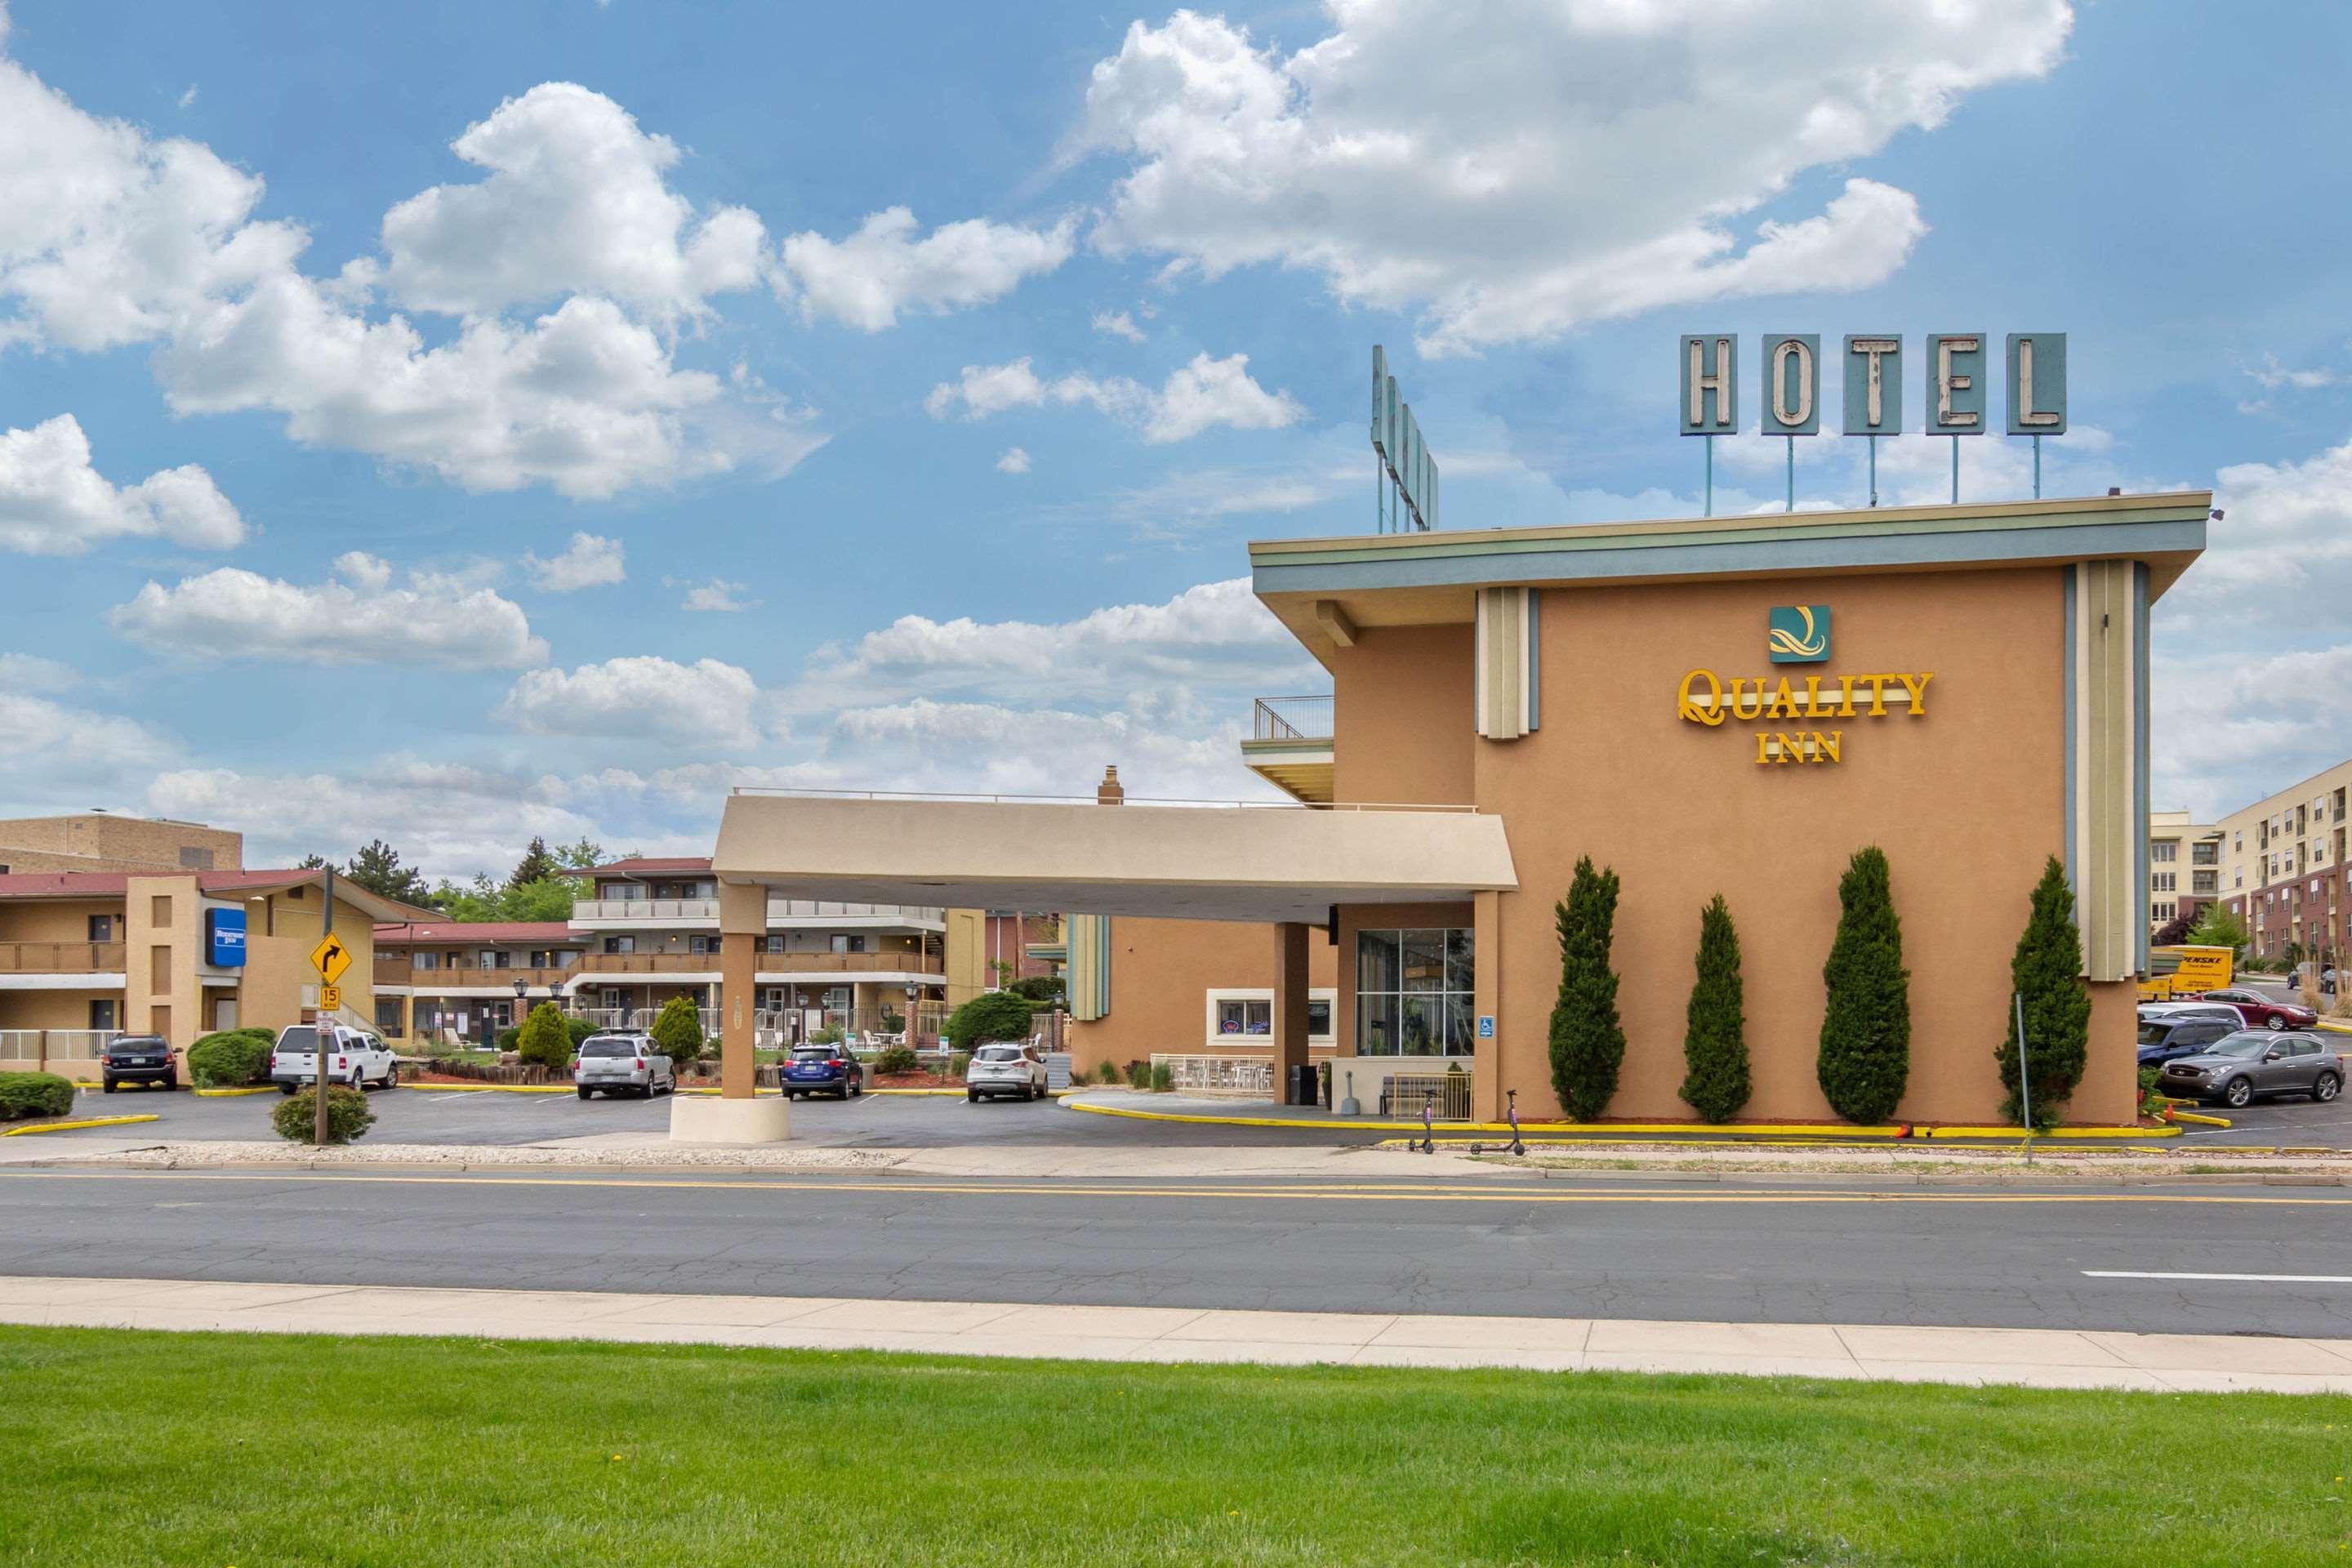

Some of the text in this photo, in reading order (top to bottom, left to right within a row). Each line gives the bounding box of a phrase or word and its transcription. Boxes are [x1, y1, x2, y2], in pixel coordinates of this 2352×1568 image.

[1690, 338, 2059, 426] HOTEL
[1678, 668, 1935, 726] QUALITY
[1755, 730, 1842, 764] INN
[323, 989, 336, 1001] 15
